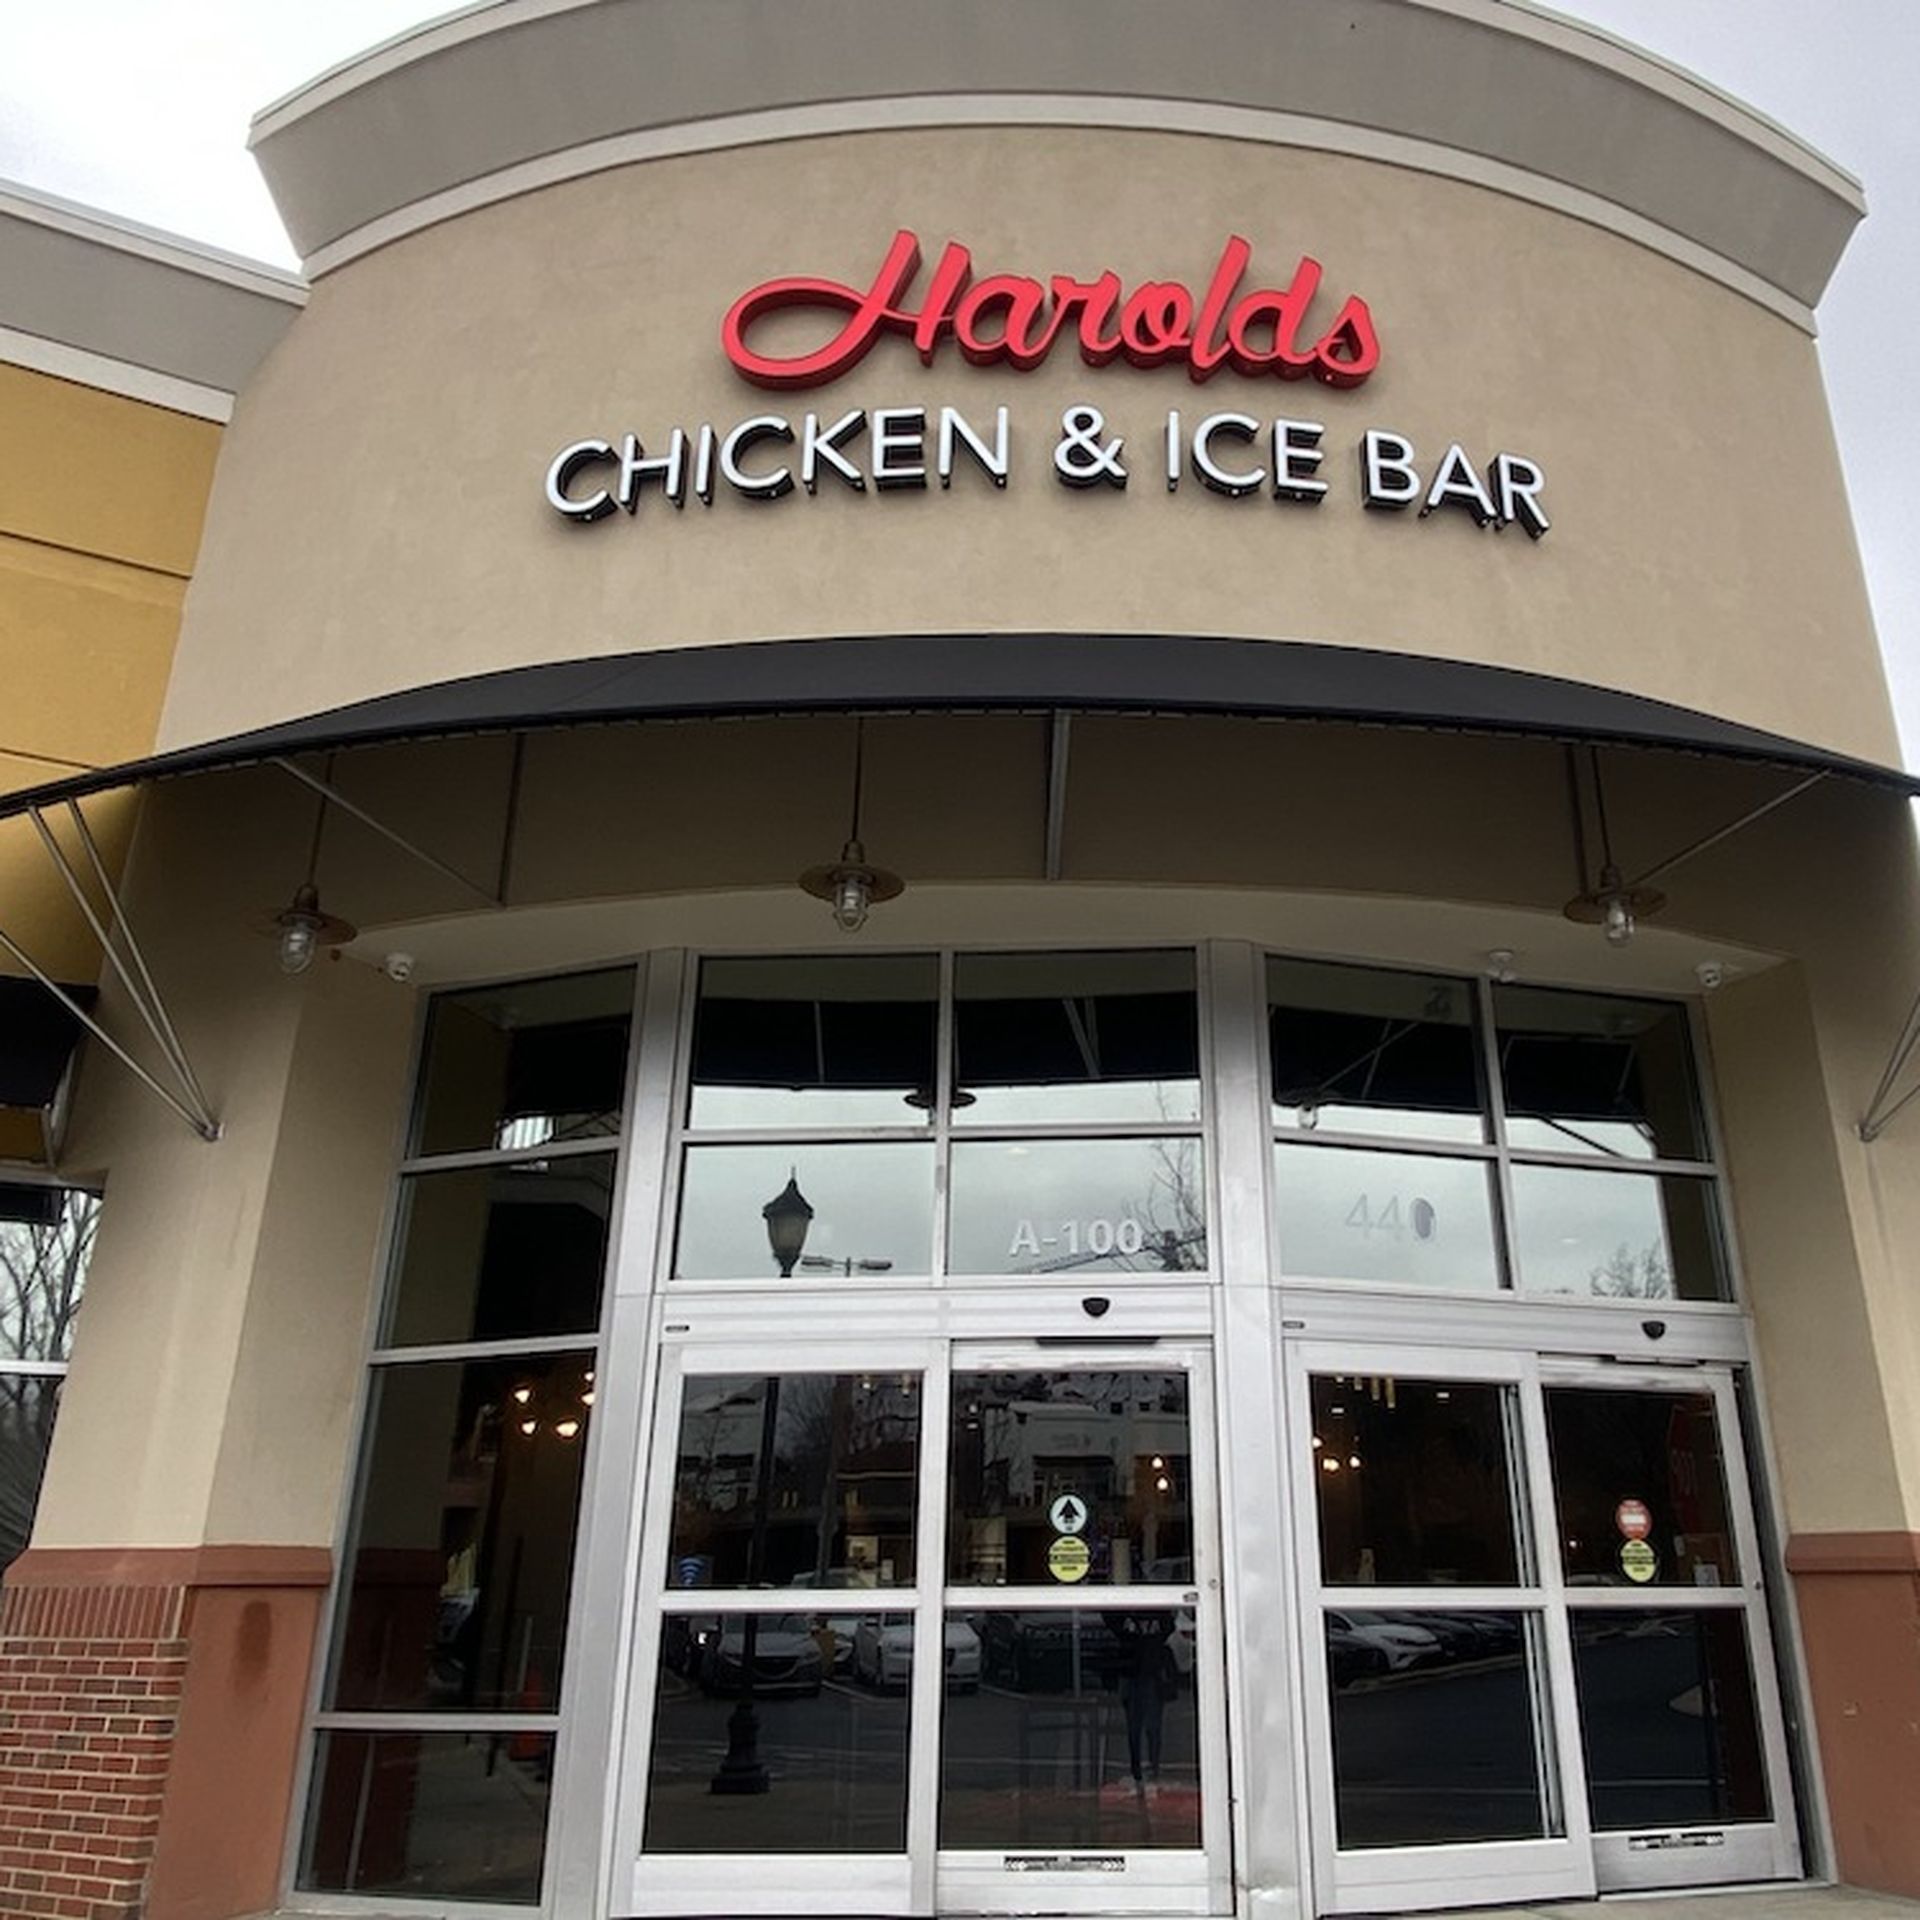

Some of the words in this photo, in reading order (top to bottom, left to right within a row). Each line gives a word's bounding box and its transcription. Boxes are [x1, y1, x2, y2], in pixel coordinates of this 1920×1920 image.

[721, 229, 1381, 389] Harolds
[544, 405, 1010, 523] CHICKEN
[1053, 405, 1128, 489] &
[1164, 409, 1328, 502] ICE
[1360, 430, 1552, 538] BAR
[1009, 1218, 1145, 1257] A-100
